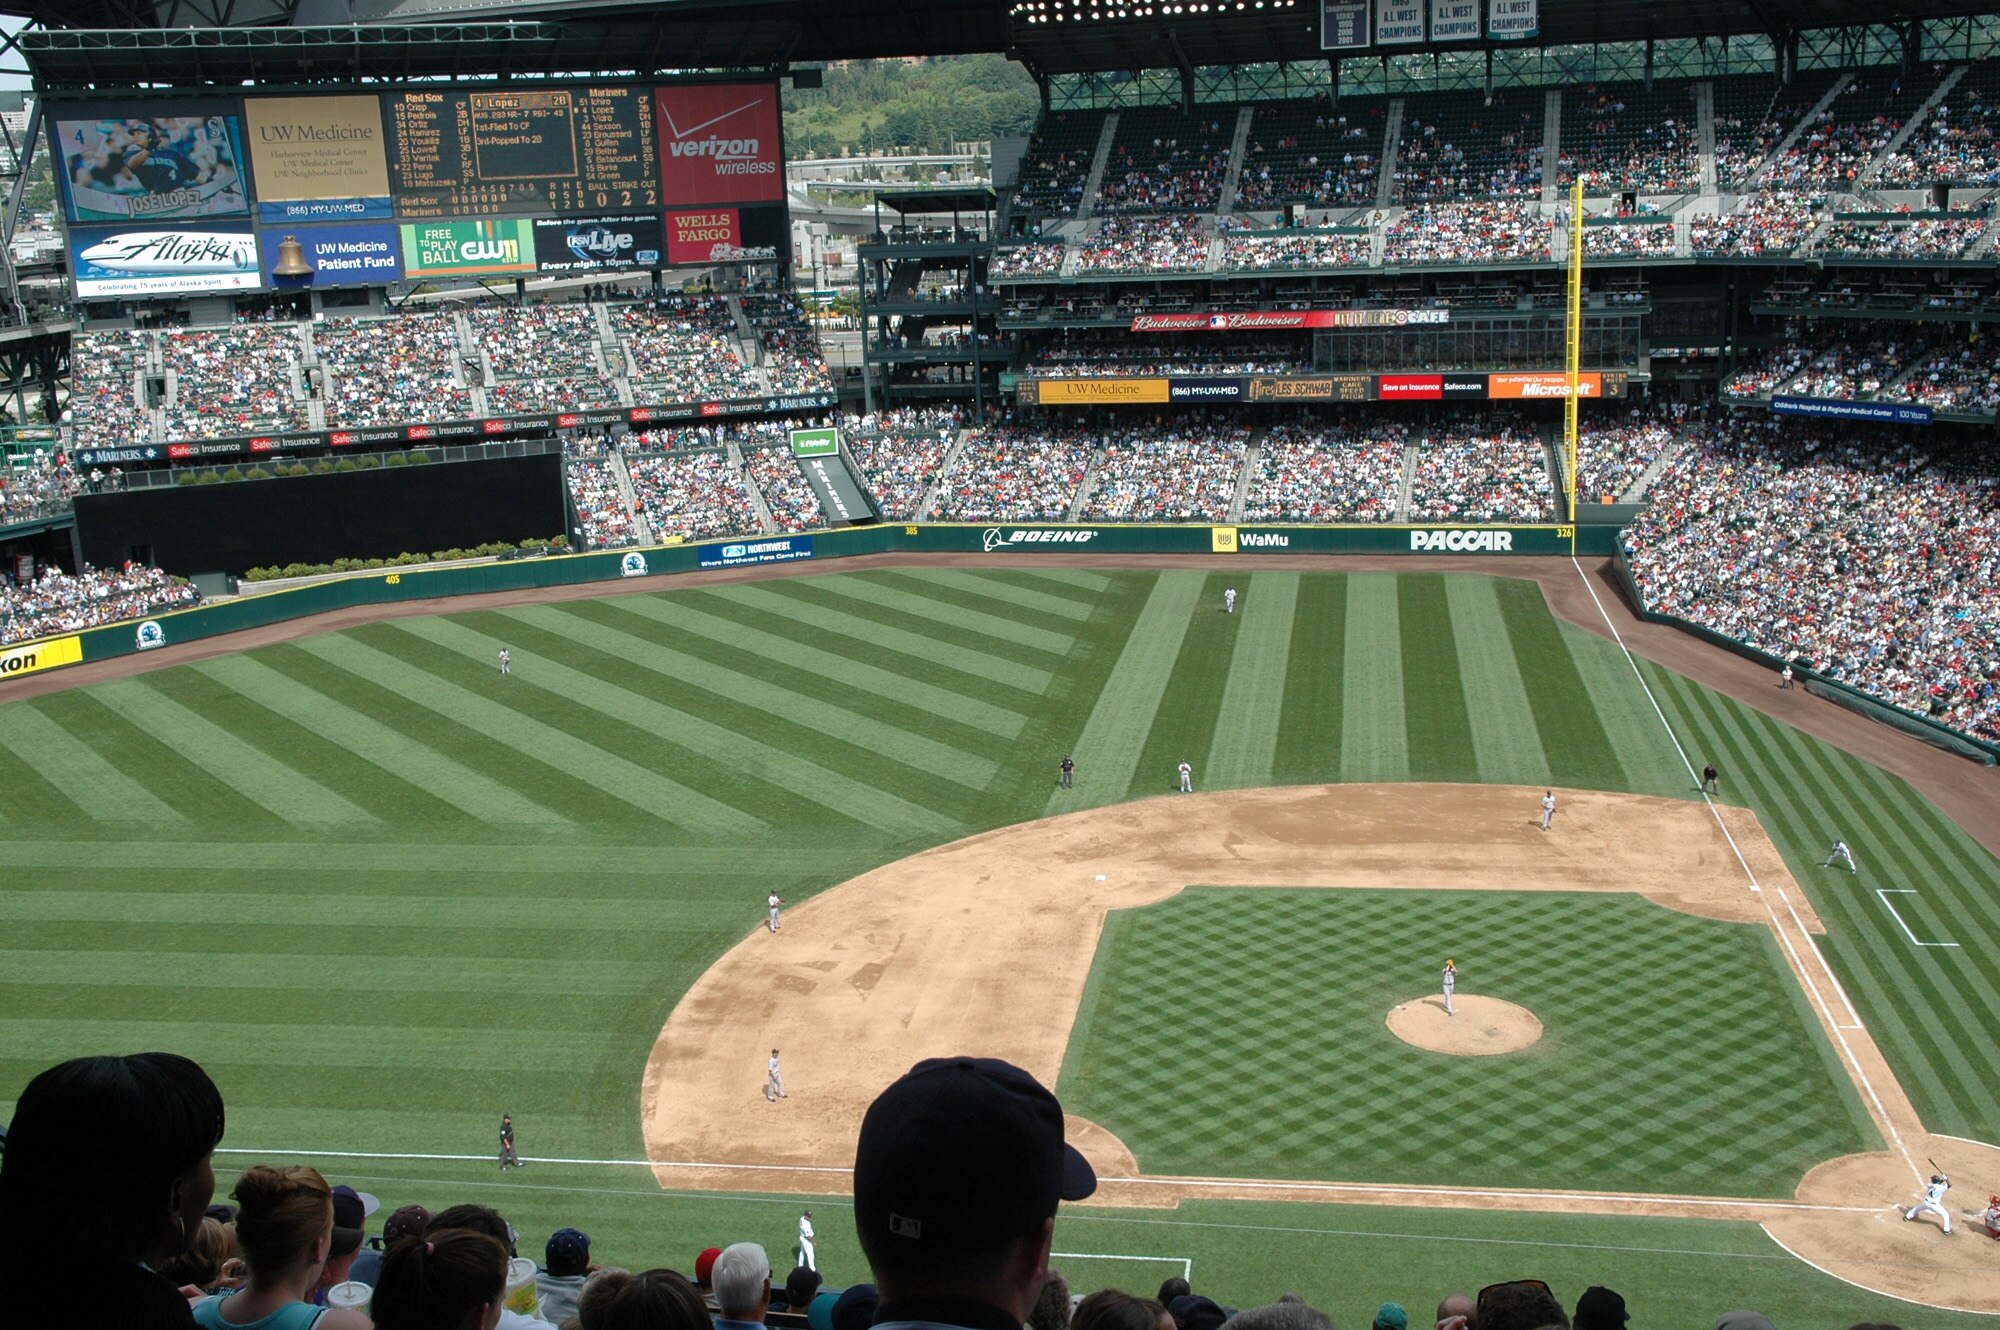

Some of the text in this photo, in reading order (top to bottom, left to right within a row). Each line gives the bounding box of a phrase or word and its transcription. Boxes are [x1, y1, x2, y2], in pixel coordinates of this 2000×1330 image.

[1453, 6, 1472, 18] WEST
[1510, 2, 1530, 13] WEST
[1398, 10, 1417, 21] WEST
[1434, 22, 1477, 36] CHAMPIONS
[1491, 17, 1535, 31] CHAMPIONS
[1379, 26, 1422, 39] CHAMPIONS
[405, 94, 443, 103] Red Sox
[589, 89, 628, 97] Mariners
[394, 103, 427, 112] 10 Crisp
[476, 98, 520, 109] 4 Lopez
[553, 96, 567, 106] 2B
[408, 120, 428, 128] Ortiz
[509, 122, 518, 130] To
[75, 129, 85, 144] 4
[260, 124, 374, 142] UW Medicine
[270, 147, 368, 158] Harborview Medical Center
[669, 135, 760, 161] verizon
[283, 160, 298, 168] UW
[714, 160, 776, 176] wireless
[168, 169, 176, 180] 4
[291, 169, 342, 179] Neighborhood
[344, 167, 369, 175] Clinics
[588, 180, 656, 190] BALL STRIKE OUT
[160, 190, 203, 209] LOPEZ
[596, 190, 656, 207] 0 2 2
[286, 203, 366, 216] (866) MY-UW-MED
[674, 214, 731, 228] WELLS
[425, 229, 452, 240] FREE
[677, 228, 731, 242] FARGO
[431, 240, 457, 251] PLAY
[589, 231, 633, 252] Live
[119, 234, 231, 265] Alaska
[315, 242, 388, 255] UW Medicine
[503, 239, 518, 258] 11
[318, 255, 395, 271] Patient Fund
[423, 250, 460, 264] BALL
[541, 259, 634, 270] Every night. 10pm.
[98, 283, 137, 292] Celebrating
[203, 279, 222, 288] Spirit
[1135, 314, 1303, 329] Budweiser Budweiser
[1334, 312, 1350, 326] HIT
[1407, 310, 1449, 323] CAFE
[1066, 383, 1140, 395] UW Medicine
[1172, 386, 1239, 397] (866) MY-UW-MED
[1277, 382, 1293, 396] LES
[1295, 382, 1331, 395] SCHWAB
[1383, 383, 1398, 391] Save
[1409, 383, 1440, 391] Insurance
[1444, 383, 1482, 391] Safeco.com
[703, 401, 762, 415] Safeco Insurance
[779, 398, 819, 409] MARINERS
[1774, 402, 1798, 410] Children's
[1798, 404, 1821, 412] Hospital
[1828, 406, 1851, 414] Regional
[1873, 409, 1893, 417] Center
[560, 413, 621, 426] Safeco Insurance
[632, 407, 692, 420] Safeco Insurance
[1899, 411, 1928, 420] 100 Years
[410, 424, 474, 438] Safeco Insurance
[486, 418, 548, 432] Safeco Insurance
[252, 436, 320, 450] Safeco Insurance
[332, 430, 398, 445] Safeco Insurance
[96, 448, 142, 463] MARINERS
[170, 442, 240, 456] Safeco Insurance
[811, 460, 849, 519] MARINERS
[905, 526, 917, 535] 385
[1008, 530, 1092, 543] BOEING
[1556, 528, 1572, 538] 326
[1239, 533, 1288, 547] WaMu
[1410, 530, 1512, 551] PACCAR
[747, 541, 791, 554] NORTHWEST
[723, 556, 758, 564] Northwest
[385, 574, 400, 584] 405
